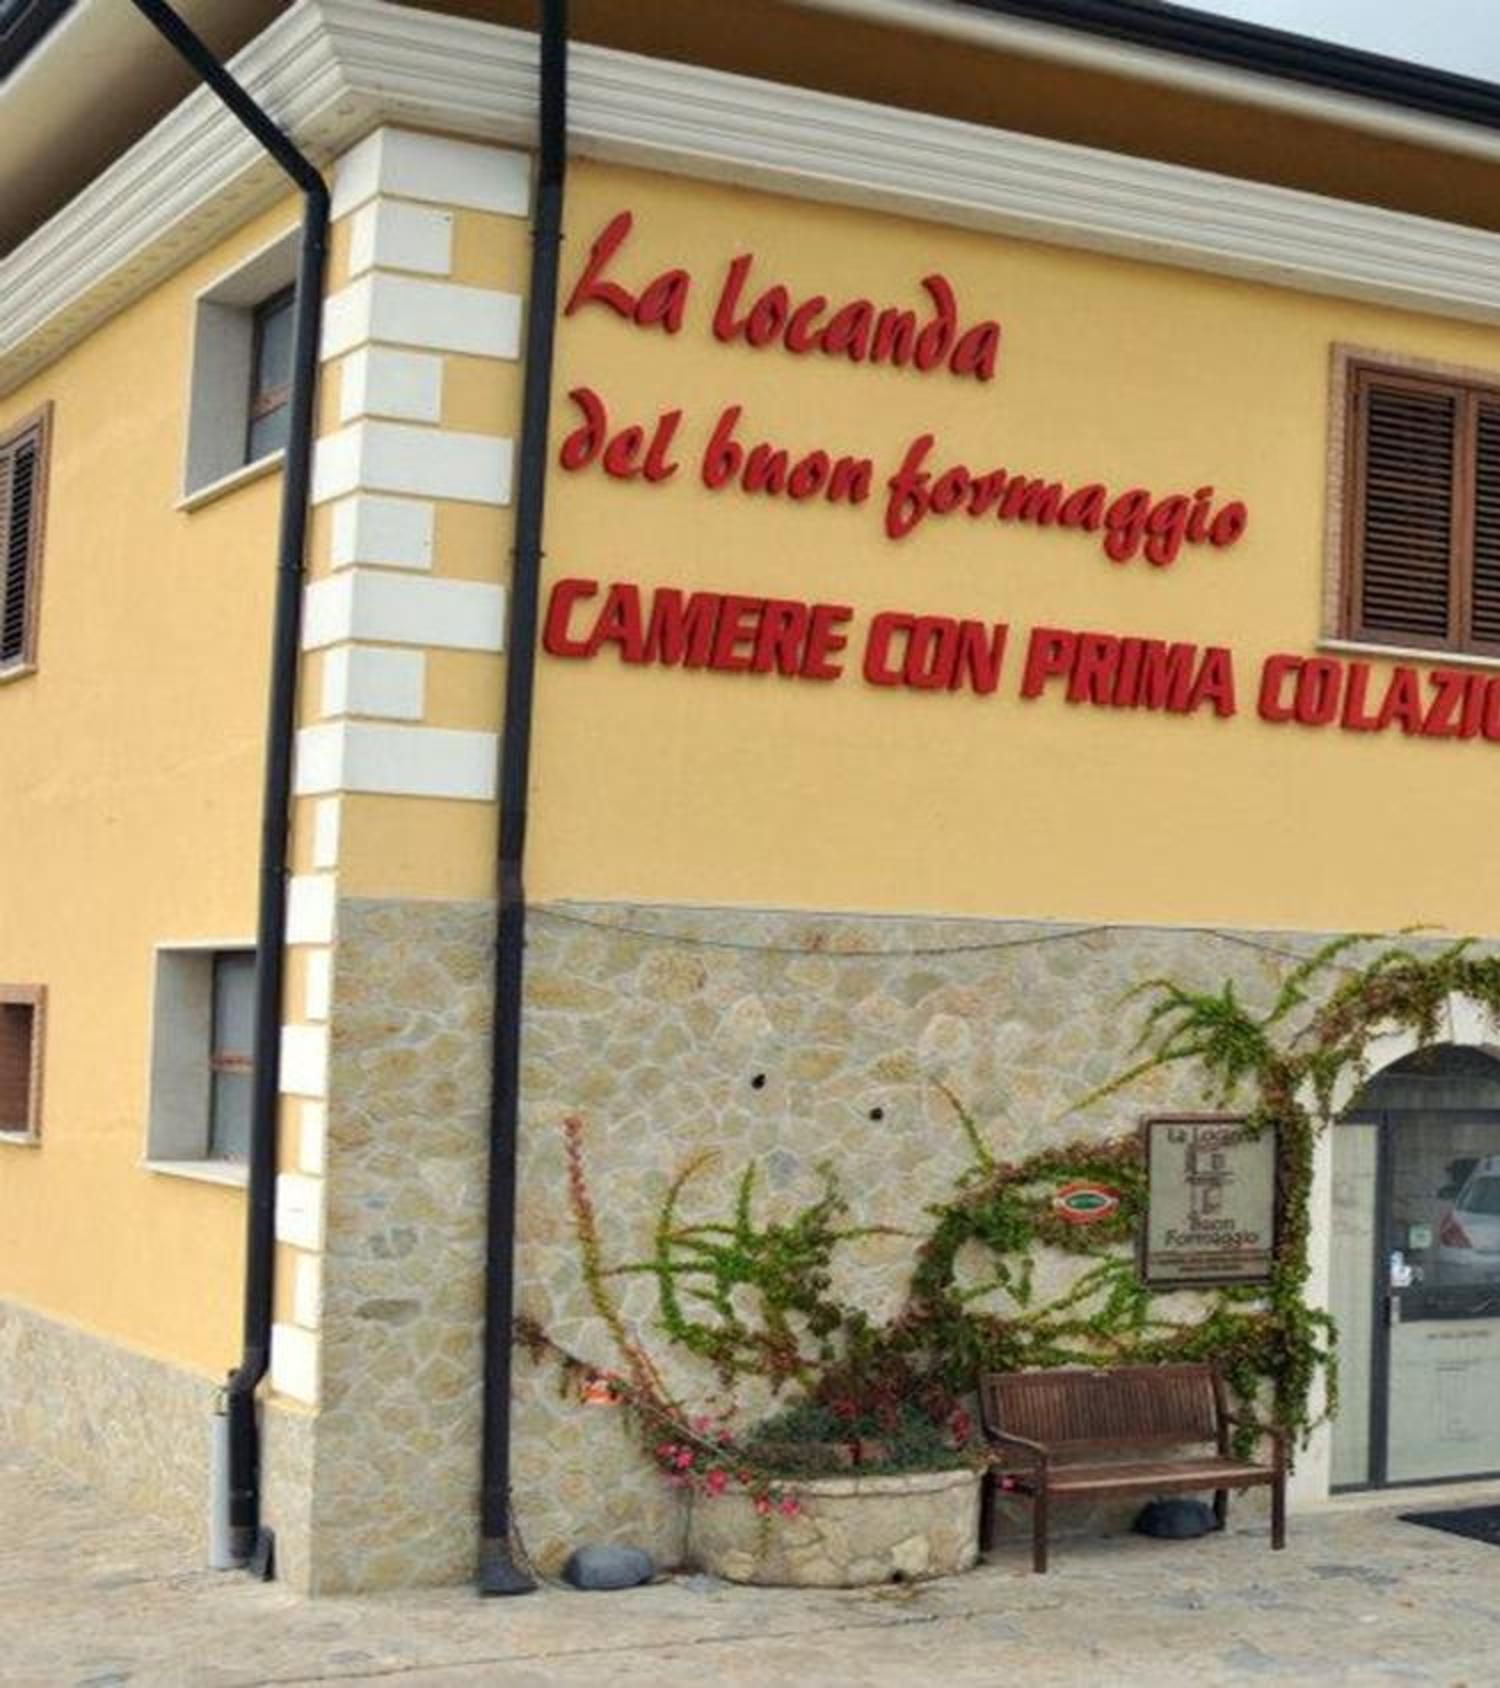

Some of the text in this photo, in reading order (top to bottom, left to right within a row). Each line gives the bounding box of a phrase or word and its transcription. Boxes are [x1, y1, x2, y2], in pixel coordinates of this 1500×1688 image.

[565, 210, 1001, 380] La locanda
[560, 387, 1249, 567] del buon formaggio
[542, 577, 852, 680] CAMERE
[862, 611, 1009, 695] CON
[1021, 627, 1238, 717] PRIMA
